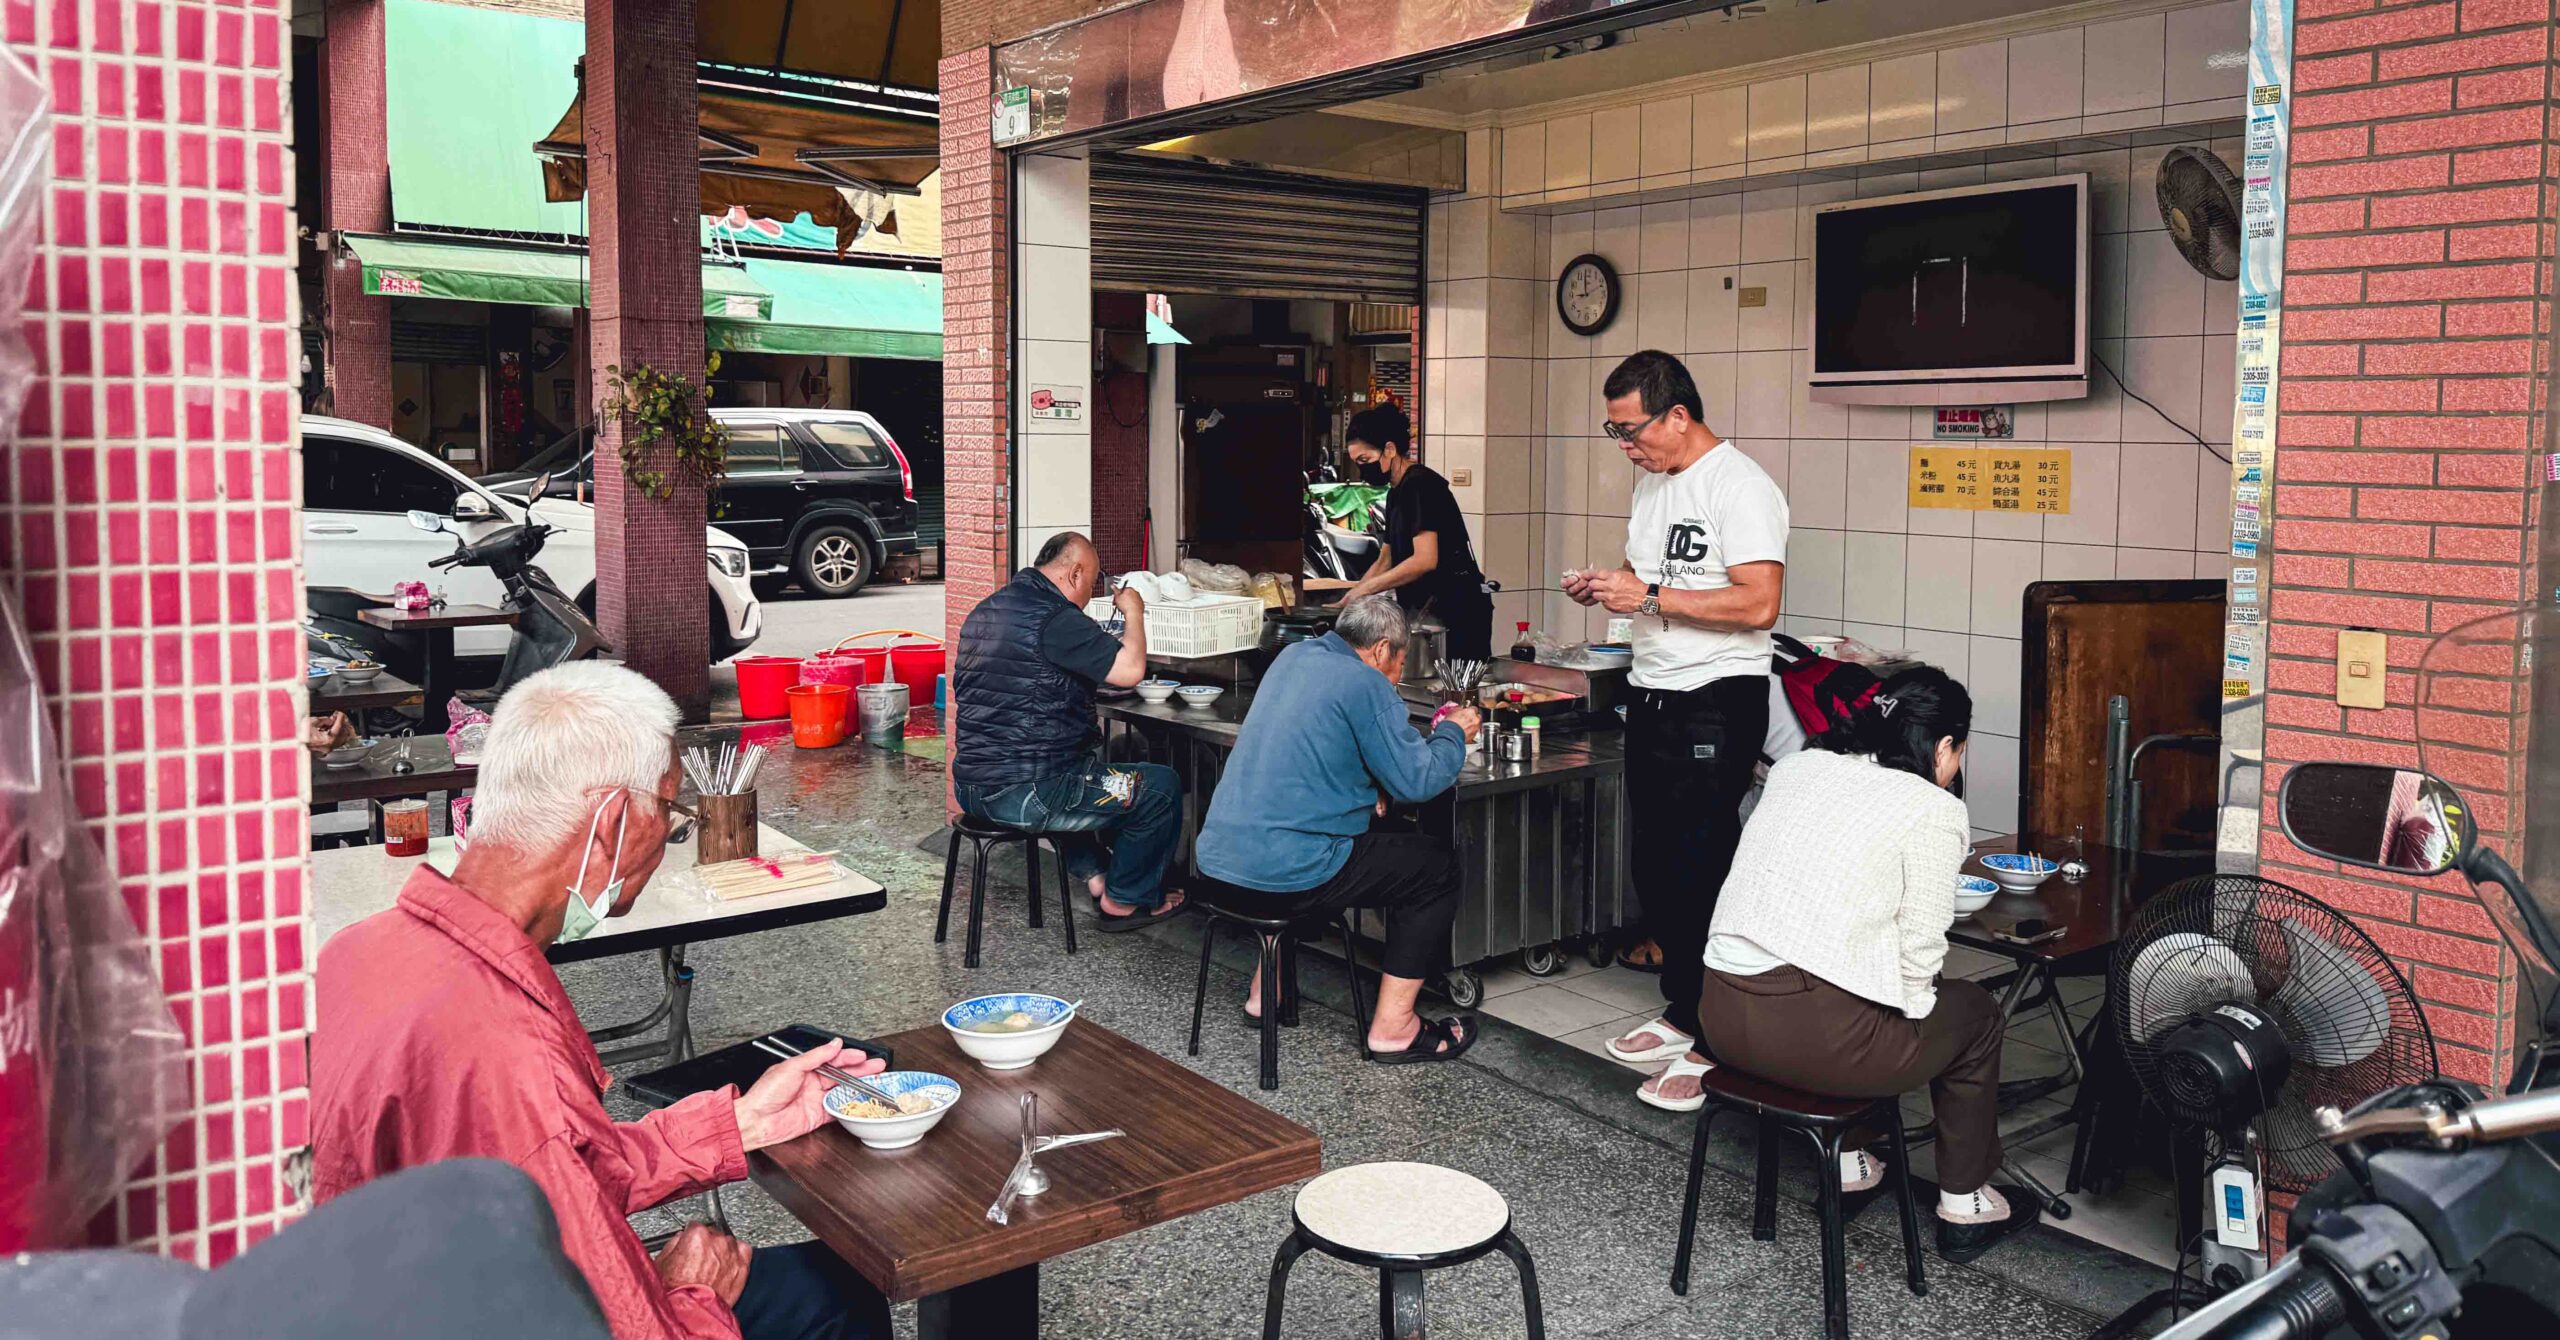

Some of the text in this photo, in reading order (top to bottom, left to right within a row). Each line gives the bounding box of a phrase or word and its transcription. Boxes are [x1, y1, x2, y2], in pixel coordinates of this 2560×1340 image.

[1009, 115, 1015, 136] 9
[1937, 424, 1980, 434] NO SMOKING
[1956, 460, 1966, 468] 45
[1967, 460, 1977, 470] 元
[2037, 462, 2048, 470] 30
[2049, 461, 2059, 471] 元
[1956, 473, 1966, 481] 45
[1967, 472, 1977, 482] 元
[2037, 475, 2047, 483] 30
[2049, 474, 2059, 485] 元
[1956, 486, 1966, 494] 70
[1967, 486, 1977, 496] 元
[2036, 488, 2047, 497] 45
[2048, 488, 2059, 498] 元
[2036, 501, 2046, 509] 25
[2048, 500, 2058, 511] 元
[1666, 523, 1709, 563] DG
